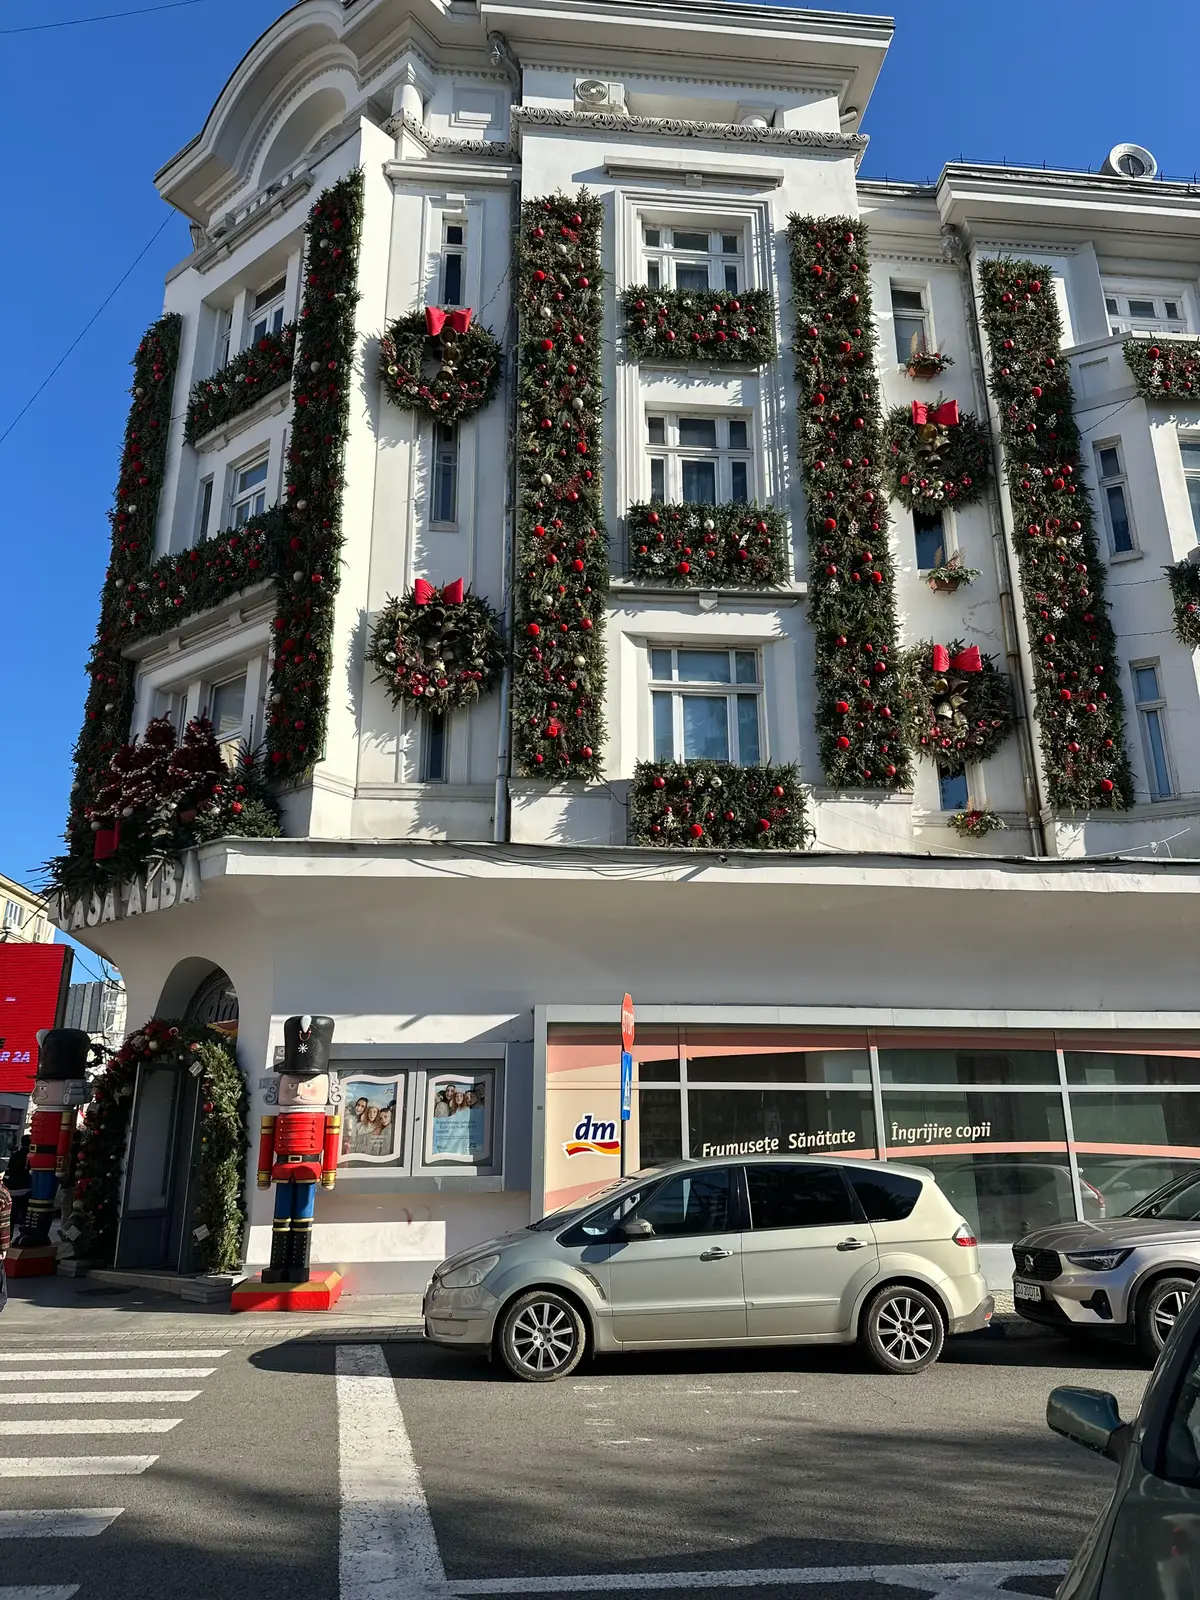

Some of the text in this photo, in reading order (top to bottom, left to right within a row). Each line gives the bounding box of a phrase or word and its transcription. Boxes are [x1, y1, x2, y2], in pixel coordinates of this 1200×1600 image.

[126, 850, 199, 918] ALBA
[622, 1010, 635, 1036] STOP
[575, 1115, 616, 1141] dm
[788, 1129, 856, 1149] Sănătate
[891, 1122, 991, 1143] Îngrijire copii
